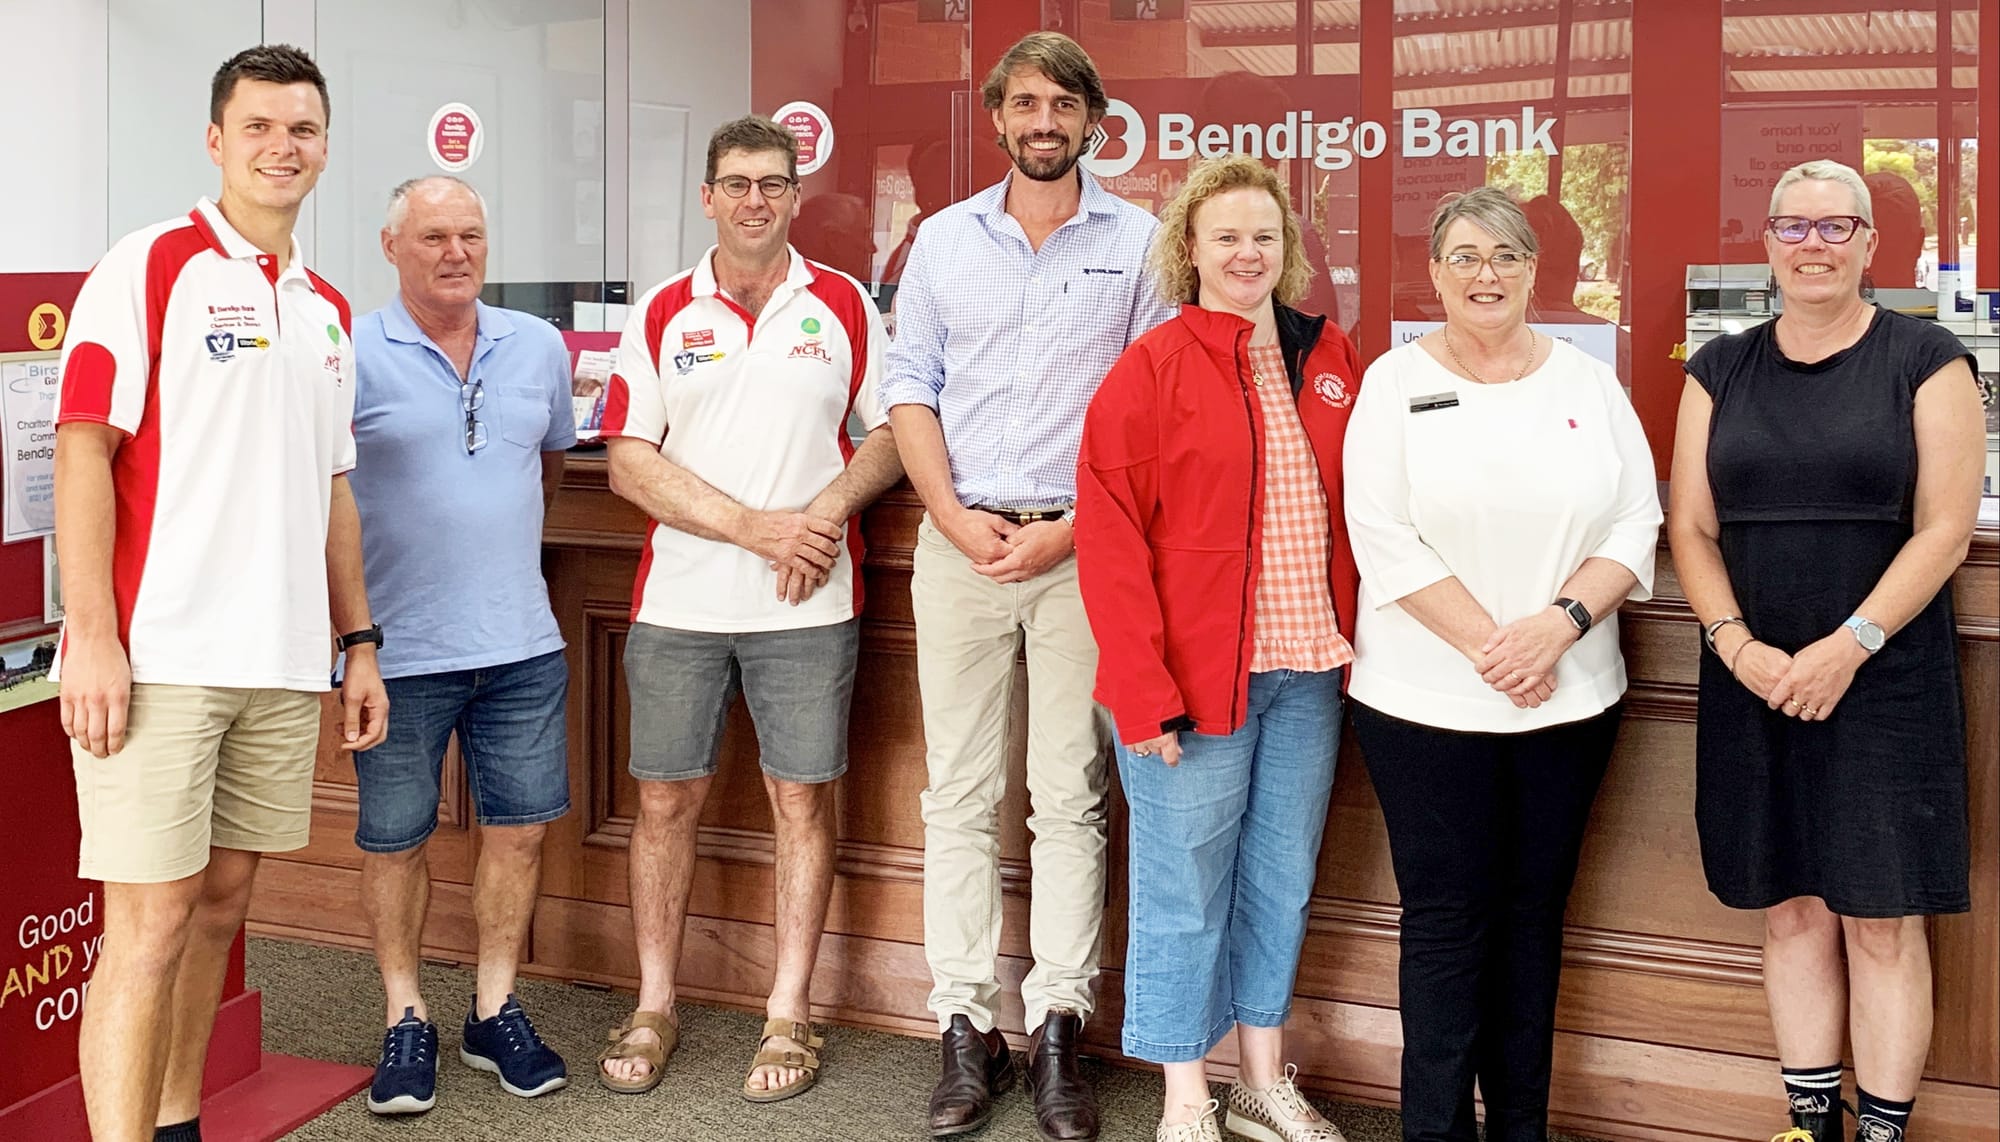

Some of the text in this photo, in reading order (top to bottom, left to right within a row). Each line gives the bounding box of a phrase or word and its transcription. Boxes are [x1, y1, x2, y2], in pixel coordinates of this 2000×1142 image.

[1158, 106, 1559, 170] Bendigo Bank
[29, 365, 59, 377] Birc
[17, 420, 52, 431] Charlton
[30, 432, 57, 443] Comm
[17, 447, 54, 461] Bendig
[18, 892, 94, 949] Good
[0, 944, 73, 1009] AND
